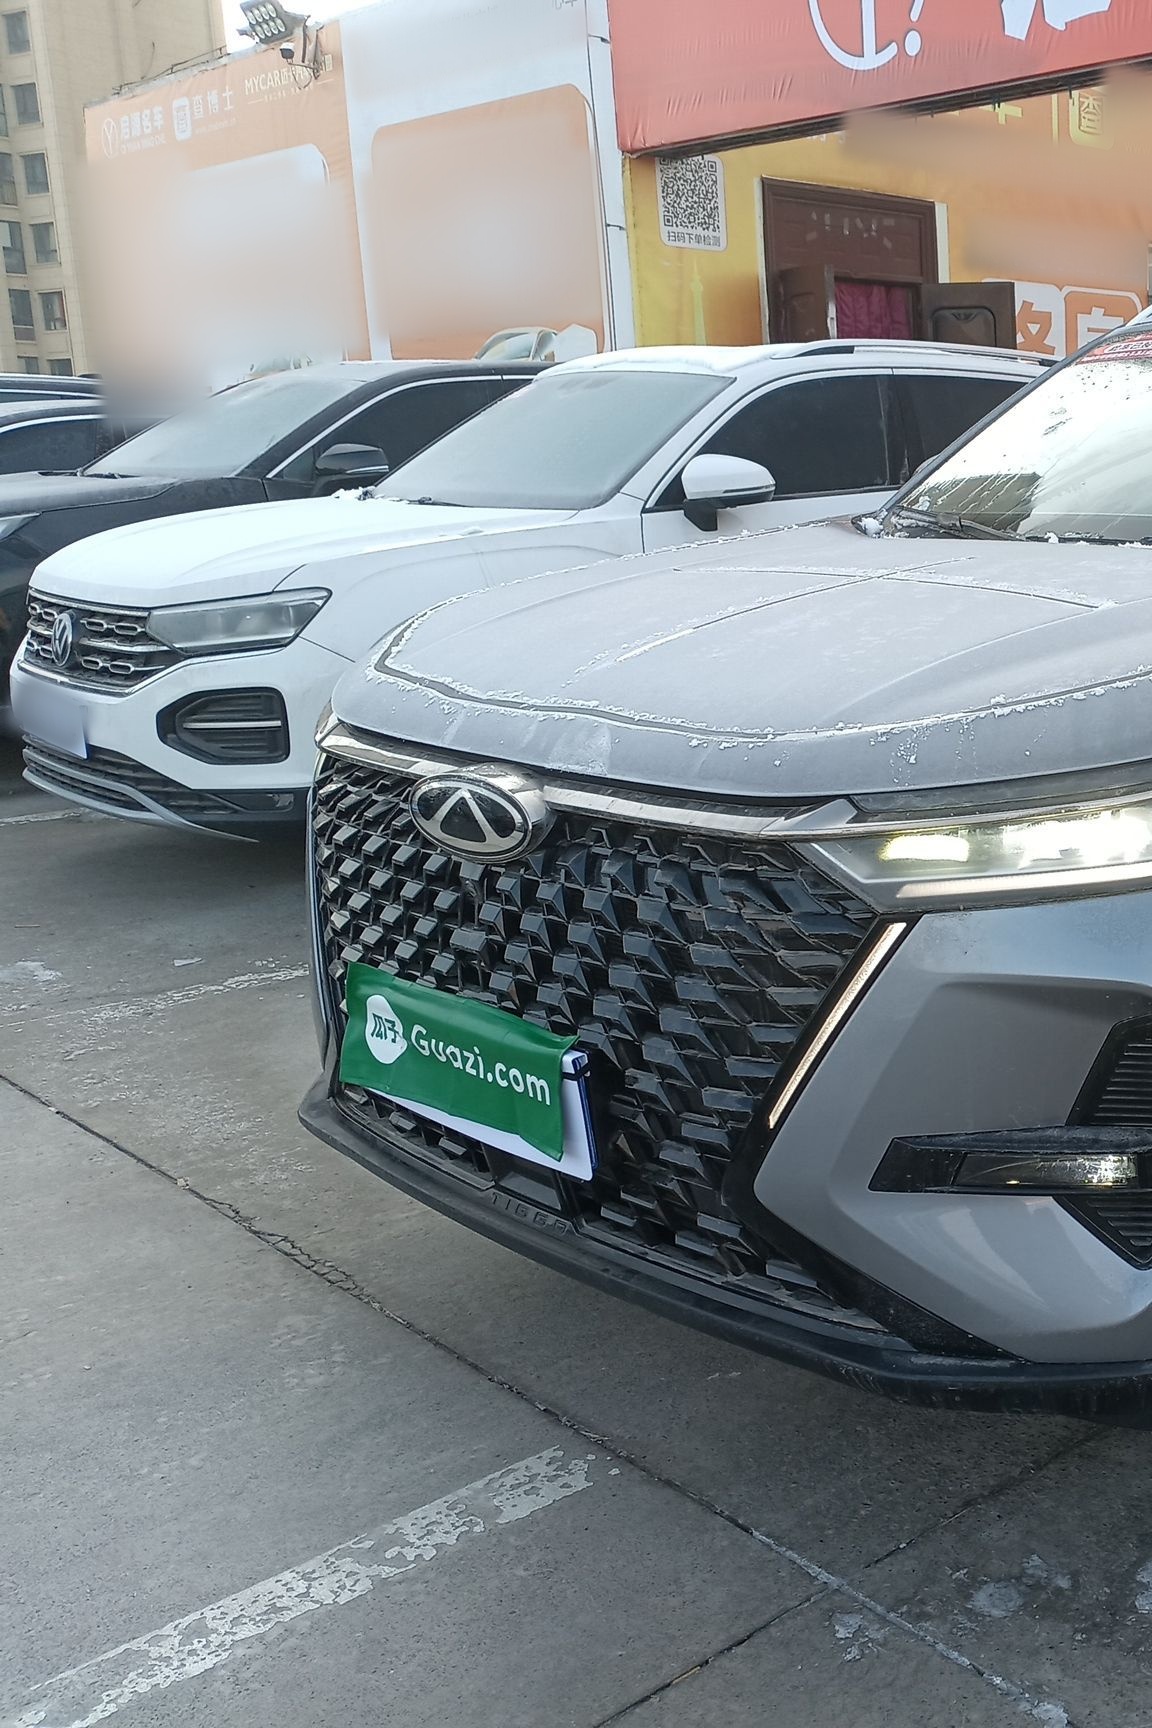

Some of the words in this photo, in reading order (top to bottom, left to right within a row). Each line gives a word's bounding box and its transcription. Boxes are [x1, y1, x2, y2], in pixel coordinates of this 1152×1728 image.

[667, 230, 721, 247] 扫码下单检测
[370, 1012, 401, 1044] 瓜子
[411, 1024, 551, 1106] Guazi.com
